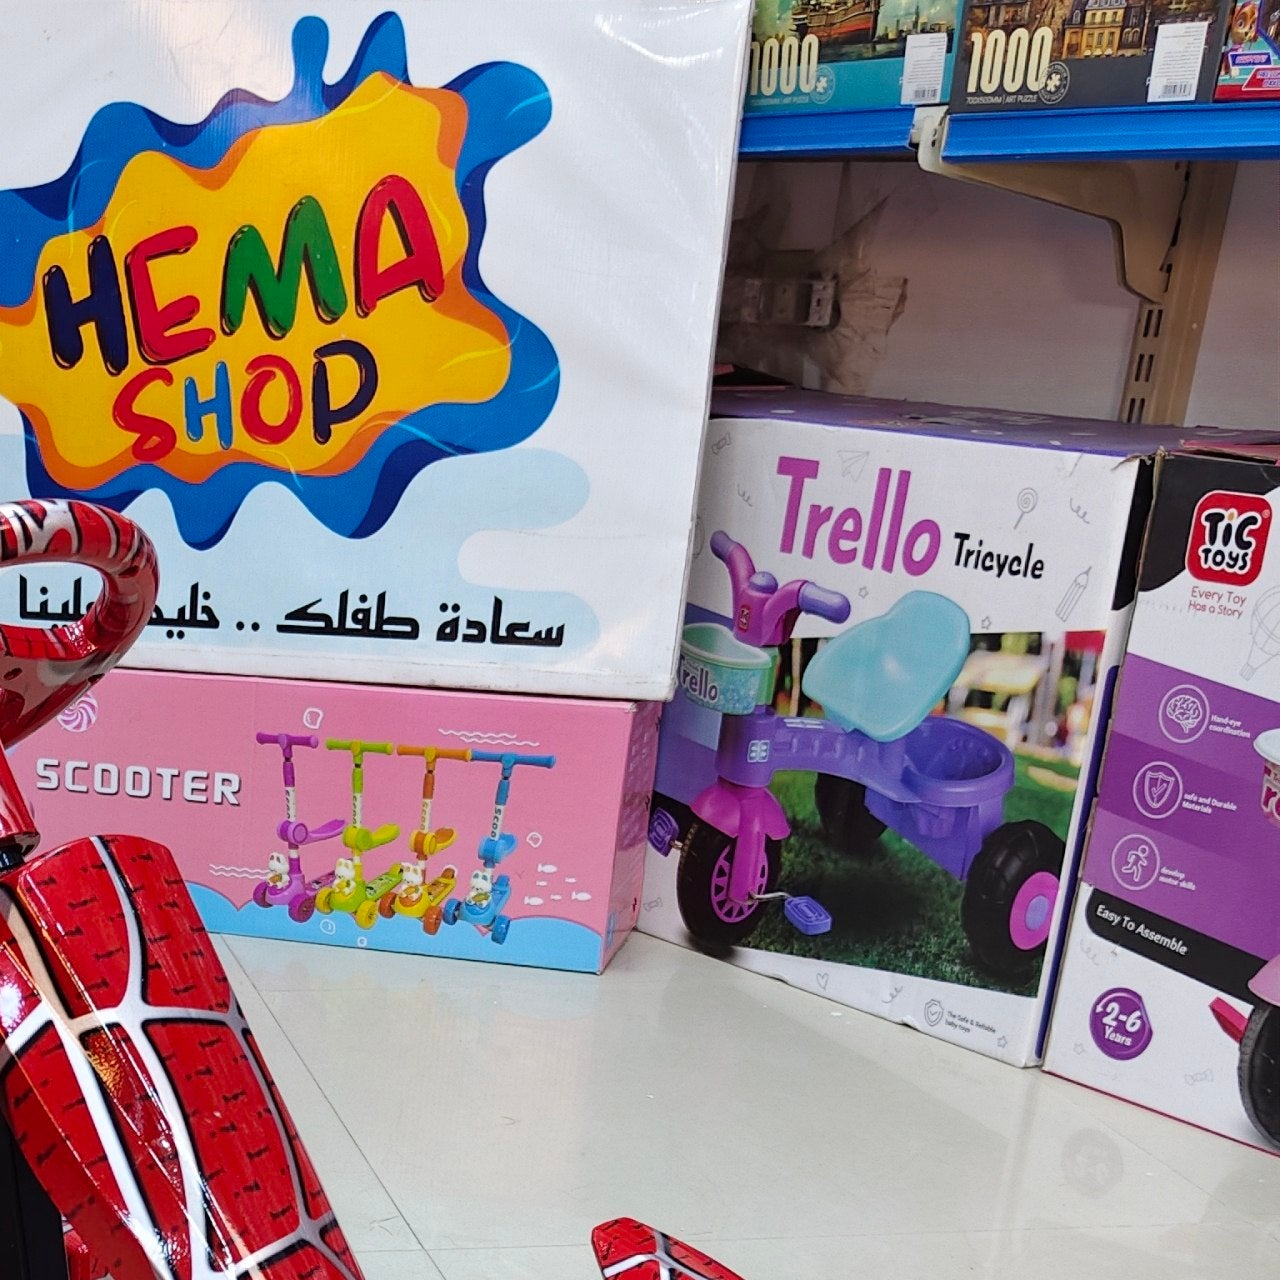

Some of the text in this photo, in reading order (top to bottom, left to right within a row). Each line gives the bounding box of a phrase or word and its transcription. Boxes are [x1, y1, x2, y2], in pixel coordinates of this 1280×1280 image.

[967, 26, 1054, 94] 1000
[40, 174, 446, 376] HEMA
[111, 339, 380, 462] SHOP
[776, 455, 1045, 580] Trello Tricycle
[275, 586, 422, 644] طفلك
[1188, 600, 1244, 620] Has a Story
[1190, 585, 1247, 606] Every Toy
[434, 597, 566, 650] سعادة
[1209, 724, 1251, 739] coordination
[35, 756, 241, 806] SCOOTER
[1182, 801, 1212, 815] Materials
[1096, 904, 1189, 956] Easy To Assemble
[1102, 1002, 1143, 1033] 2-6
[1104, 1026, 1133, 1046] Years
